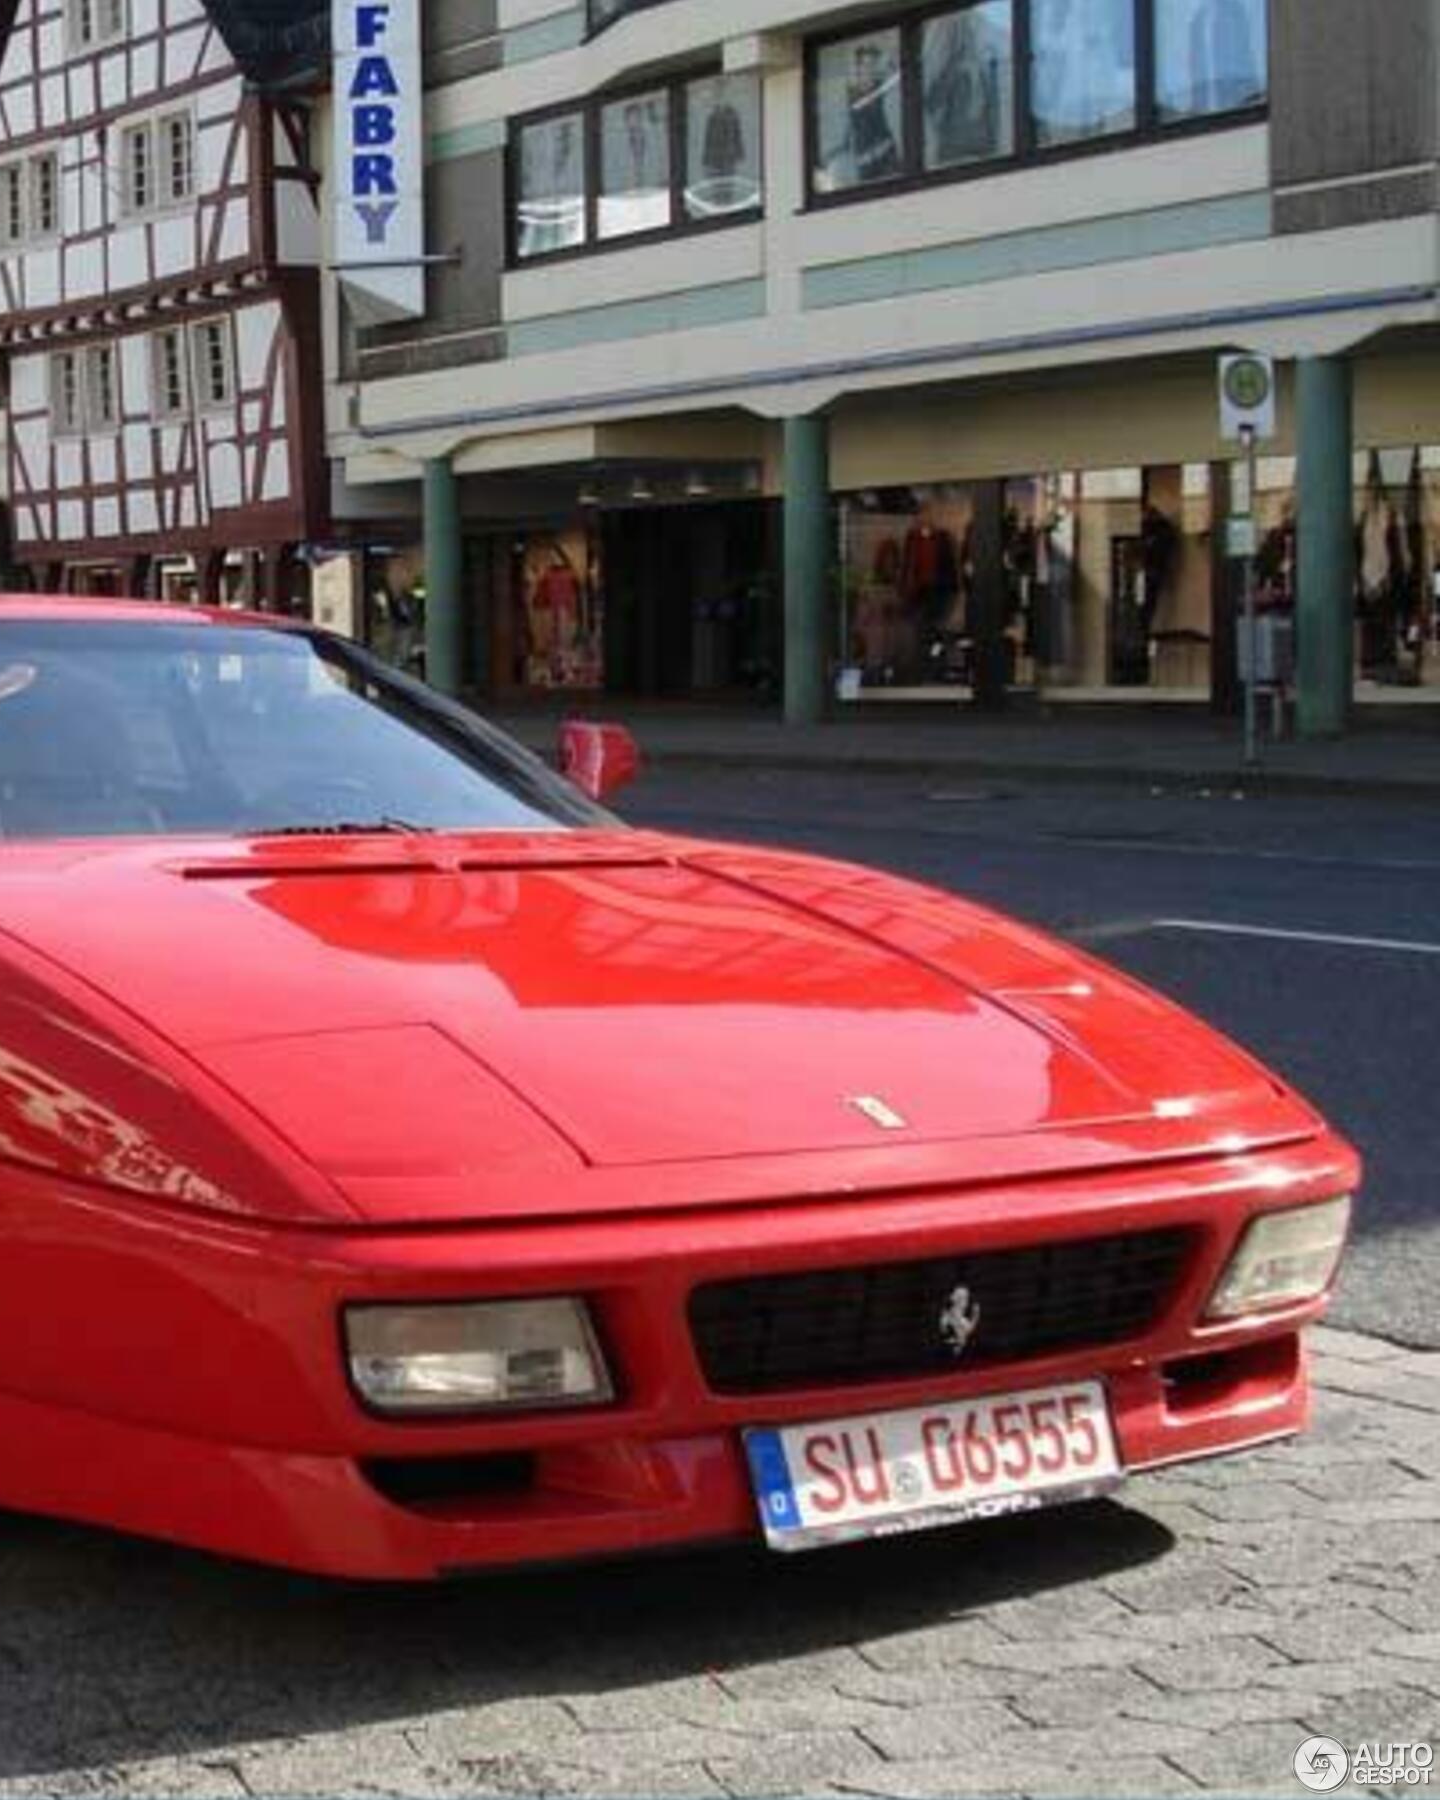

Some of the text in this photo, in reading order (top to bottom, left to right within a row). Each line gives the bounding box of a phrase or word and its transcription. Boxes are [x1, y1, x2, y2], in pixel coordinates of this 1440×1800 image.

[350, 5, 398, 243] FABRY
[804, 1394, 1099, 1512] SU 06555
